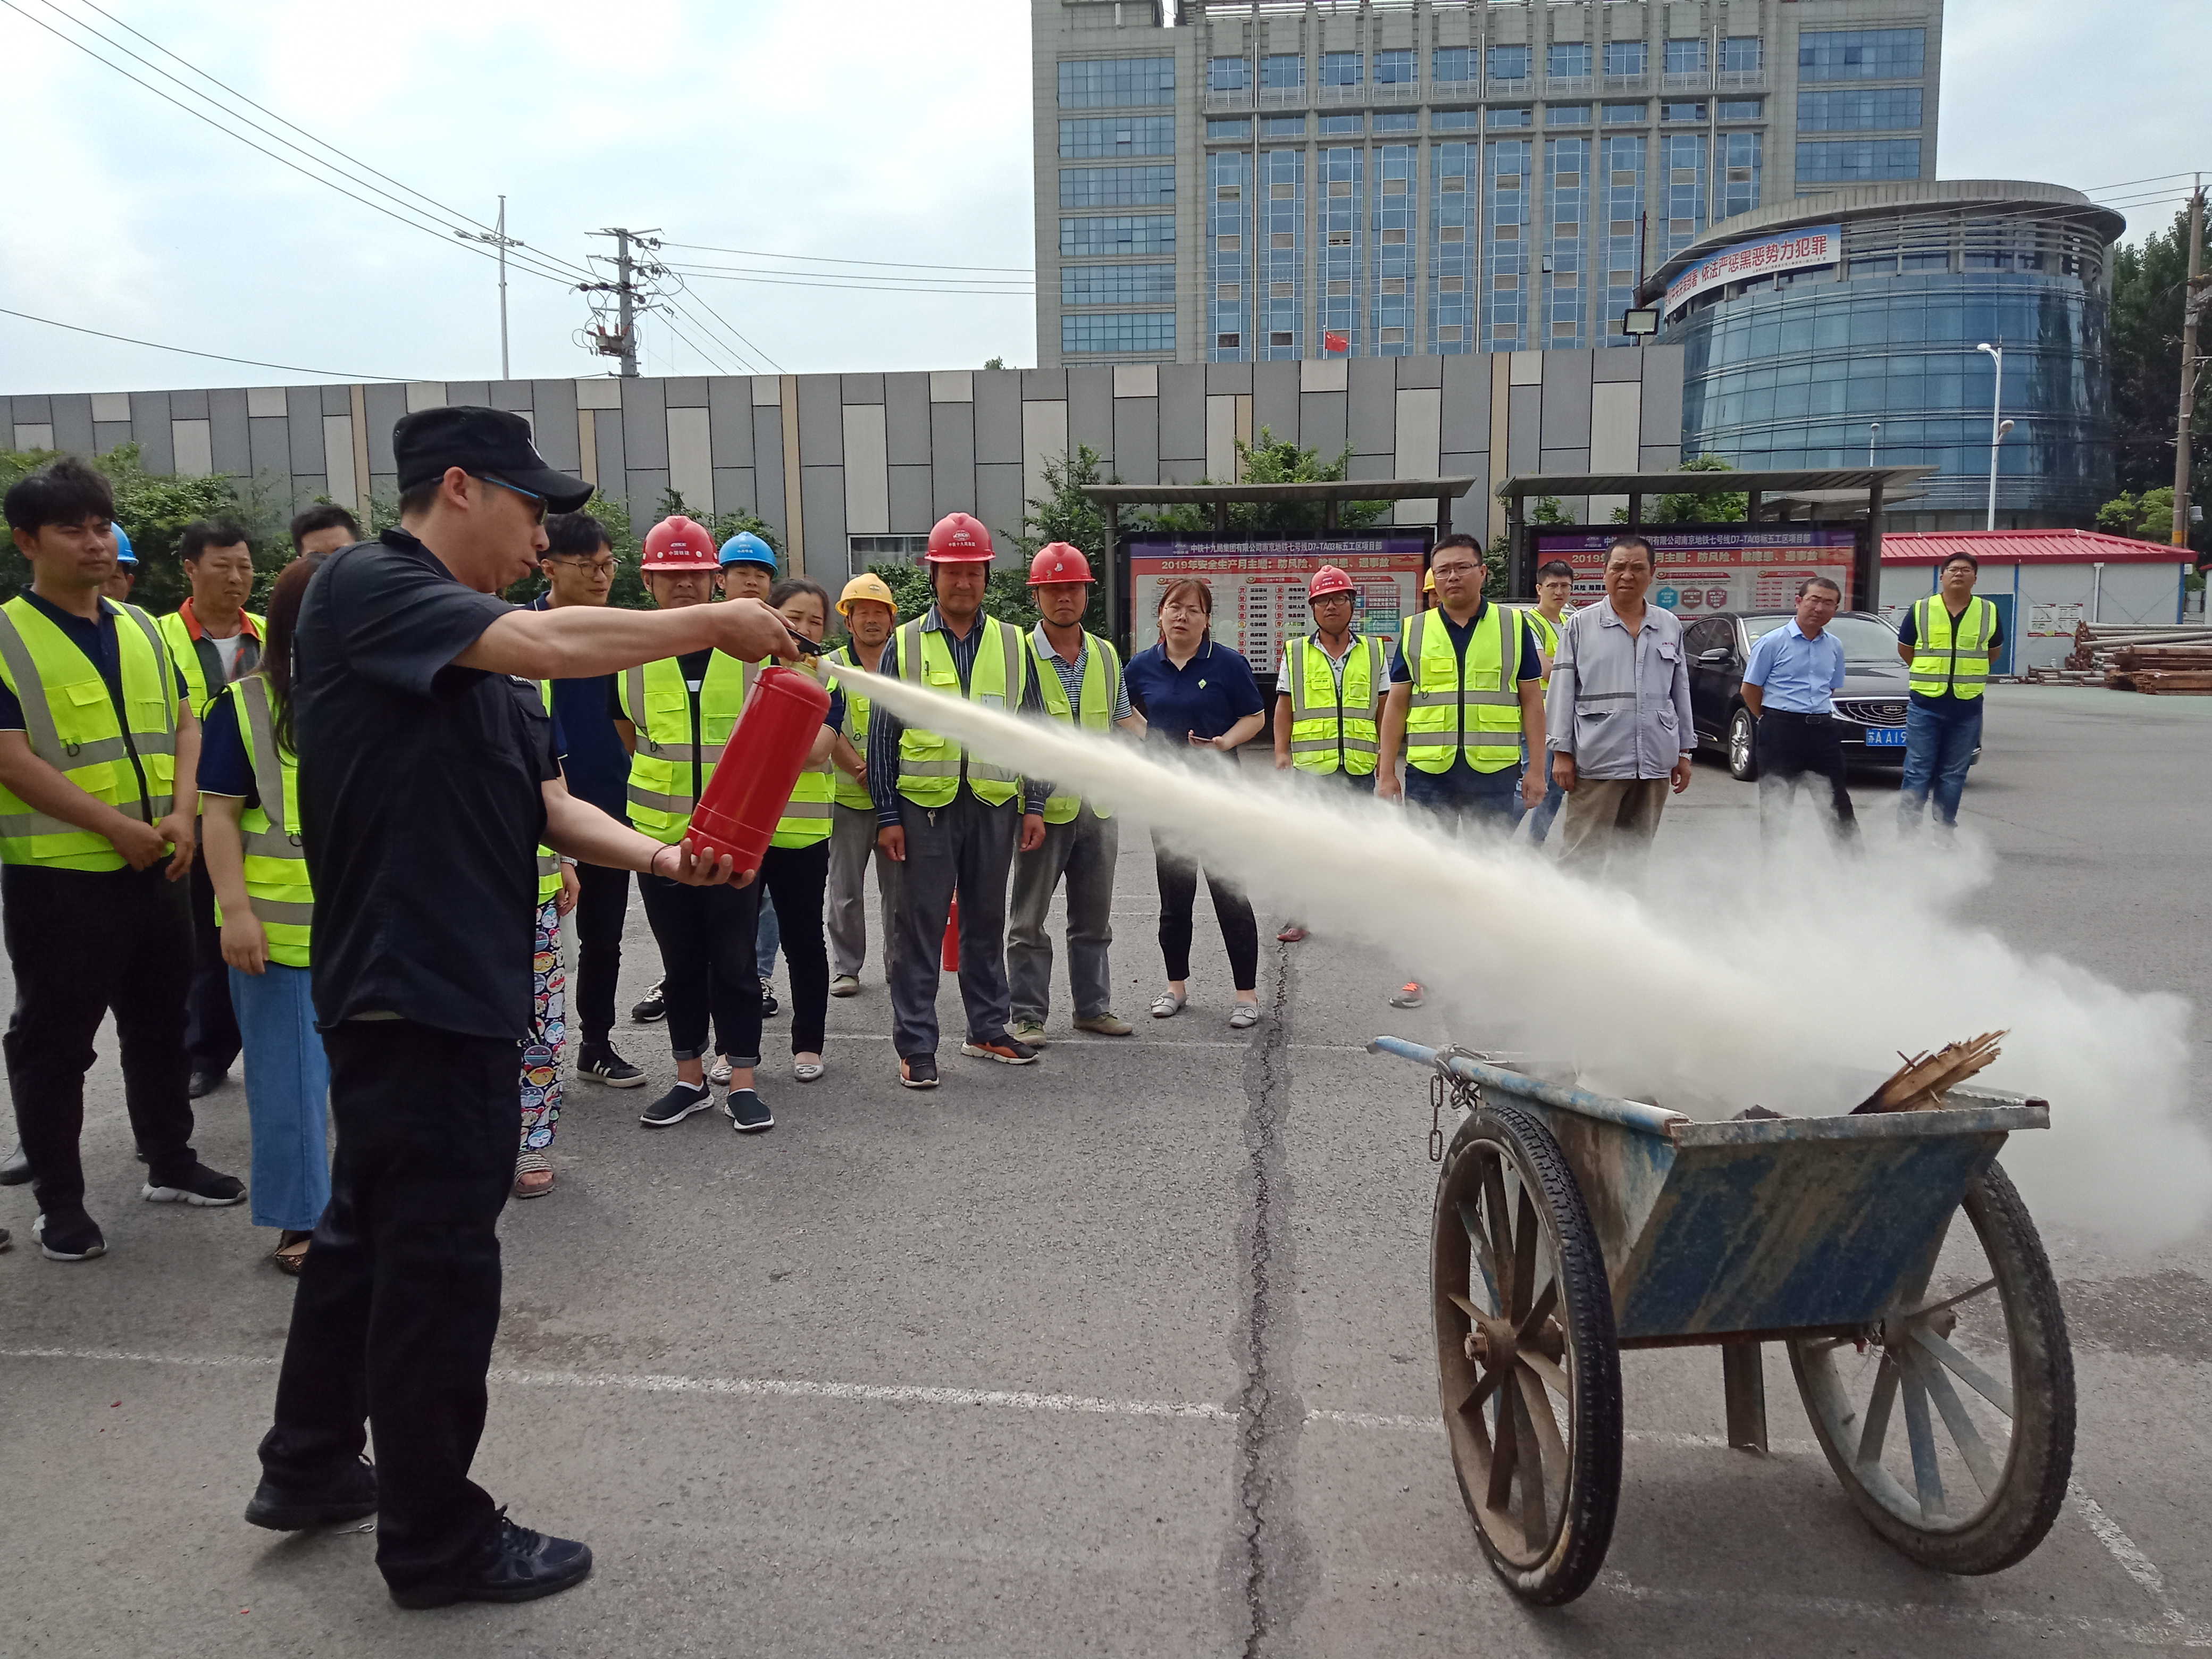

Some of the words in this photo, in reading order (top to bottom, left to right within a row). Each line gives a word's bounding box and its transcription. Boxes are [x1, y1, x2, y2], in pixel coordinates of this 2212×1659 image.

[1702, 234, 1828, 282] 依法严惩黑恶势力犯罪
[1604, 533, 1811, 547] 中团有限公司南京地铁七号线D7-TA03标五工区项目部
